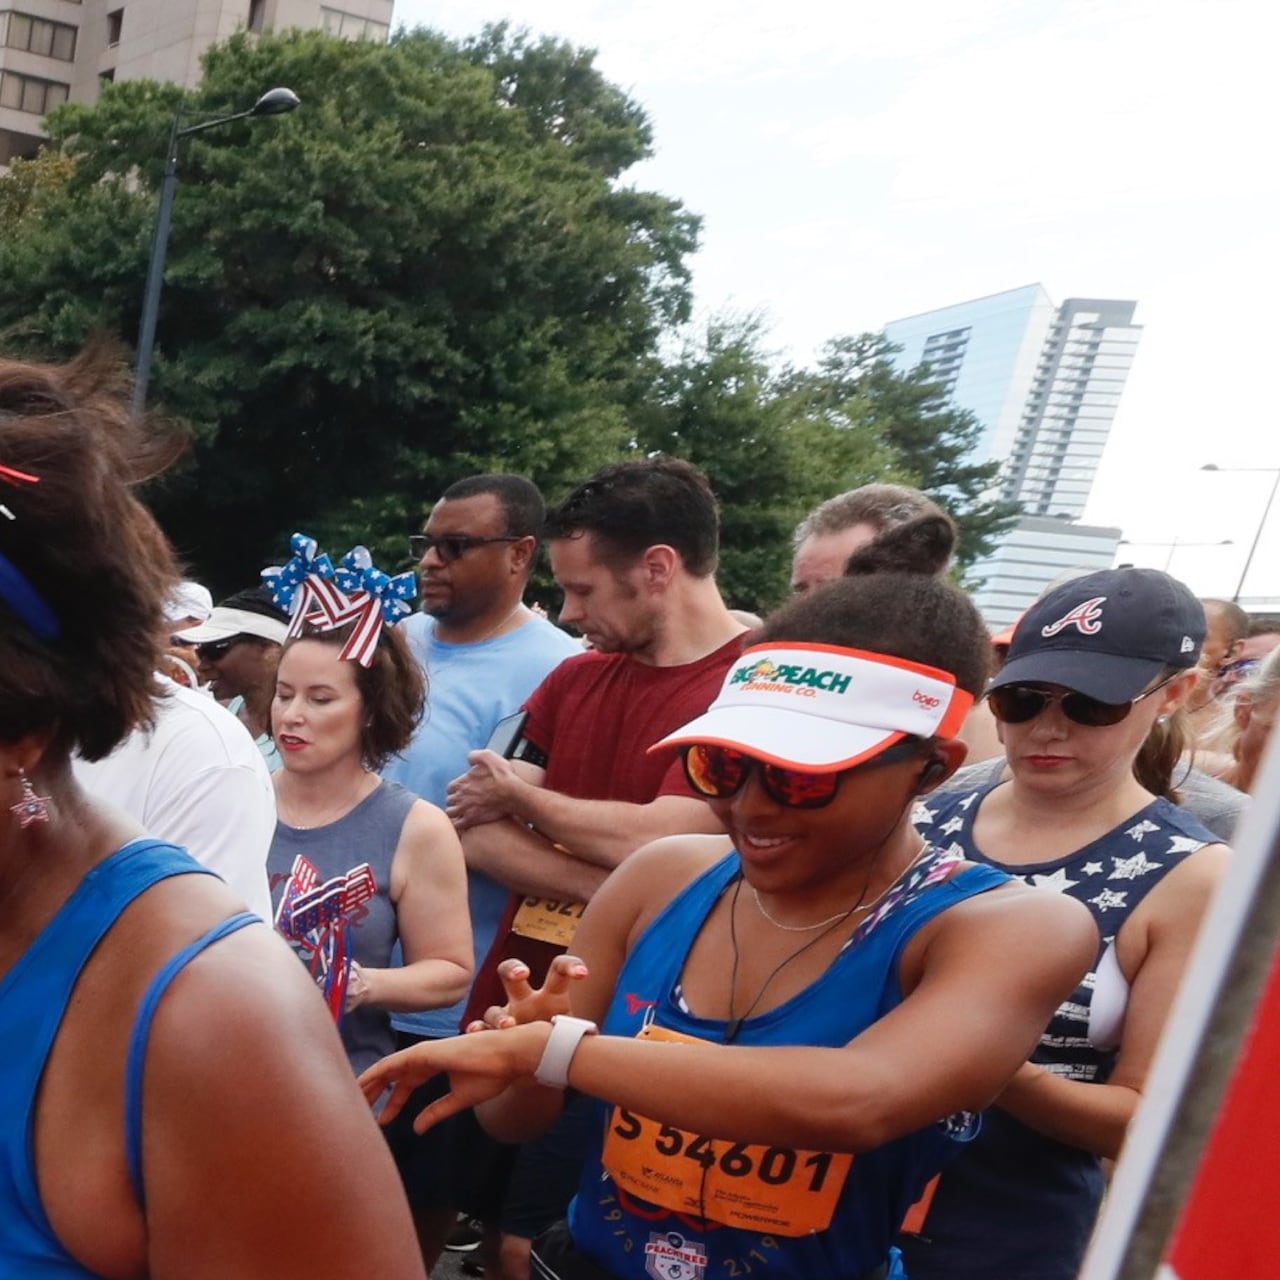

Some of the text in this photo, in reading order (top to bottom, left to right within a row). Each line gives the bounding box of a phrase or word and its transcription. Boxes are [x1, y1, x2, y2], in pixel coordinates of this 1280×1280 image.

[1041, 596, 1107, 637] A
[771, 664, 853, 694] PEACH
[795, 687, 817, 697] CO.
[614, 1107, 642, 1140] S
[655, 1126, 834, 1191] 54601
[646, 1244, 707, 1265] PEACHTREE
